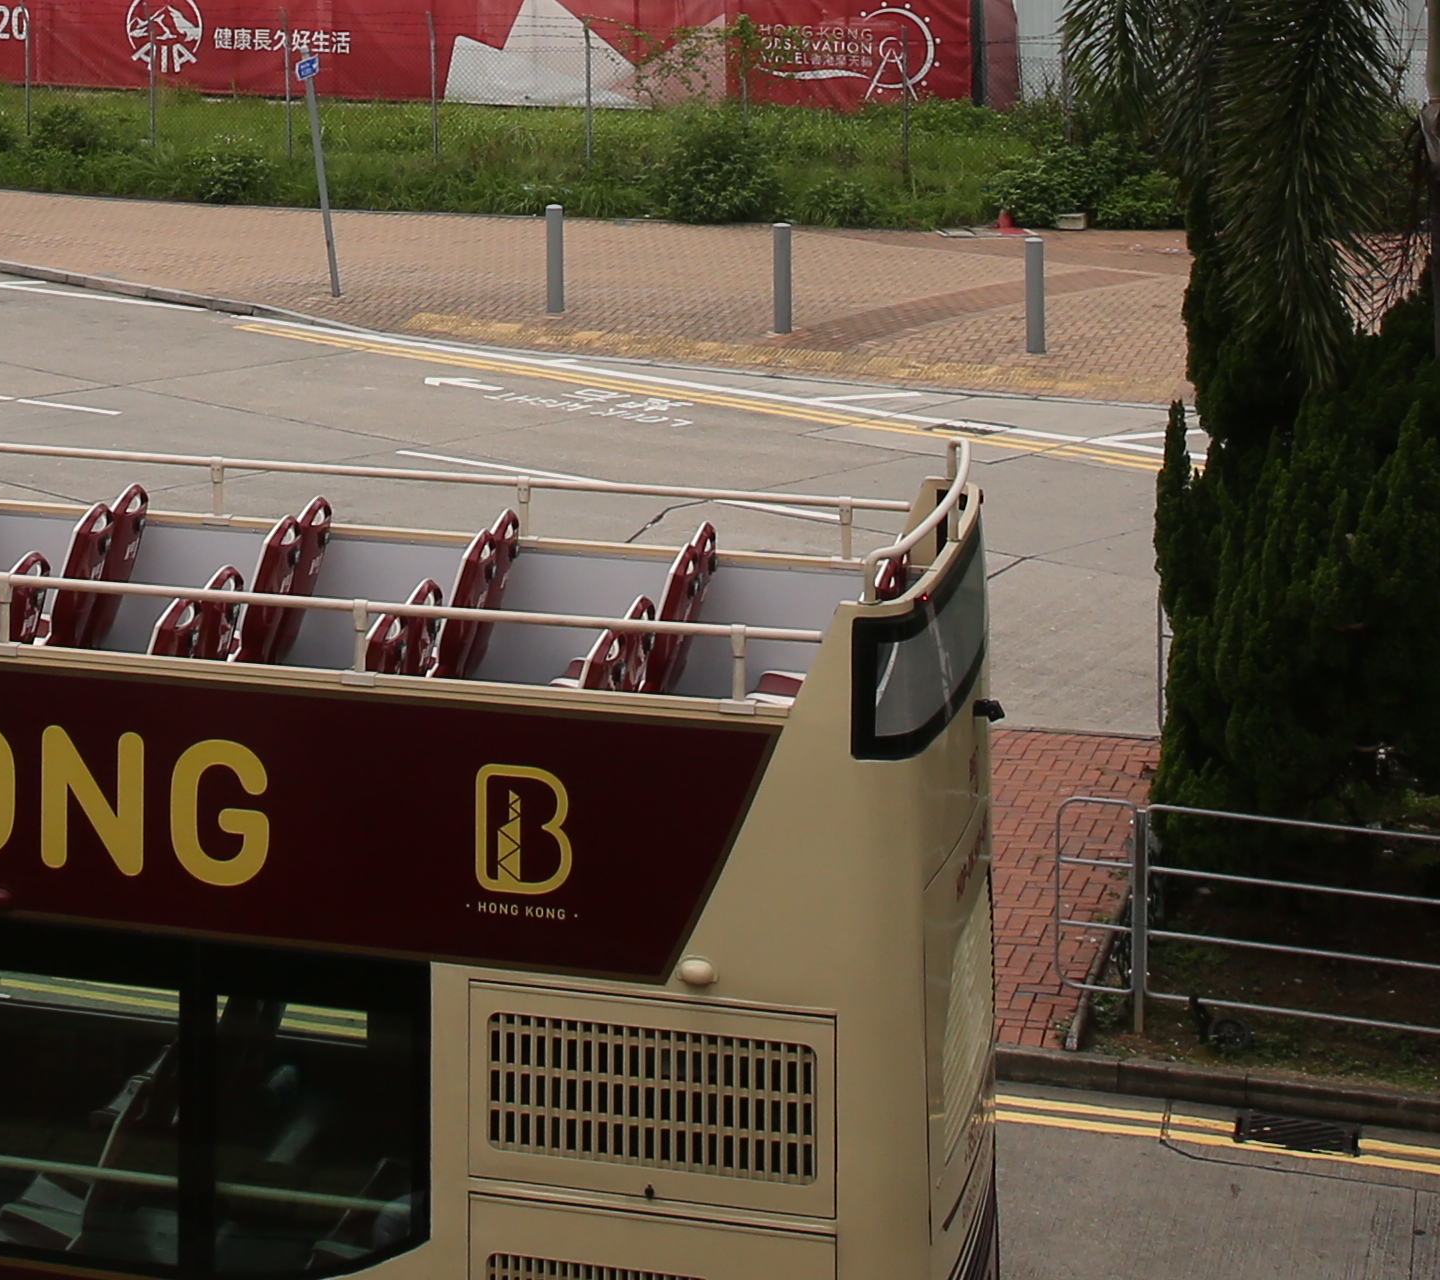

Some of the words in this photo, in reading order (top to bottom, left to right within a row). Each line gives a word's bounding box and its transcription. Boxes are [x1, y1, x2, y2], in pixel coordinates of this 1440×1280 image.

[213, 26, 351, 54] 健康長久好生活
[820, 26, 873, 41] KONG
[131, 42, 197, 73] AIA
[477, 899, 519, 918] HONG
[524, 903, 566, 921] KONG
